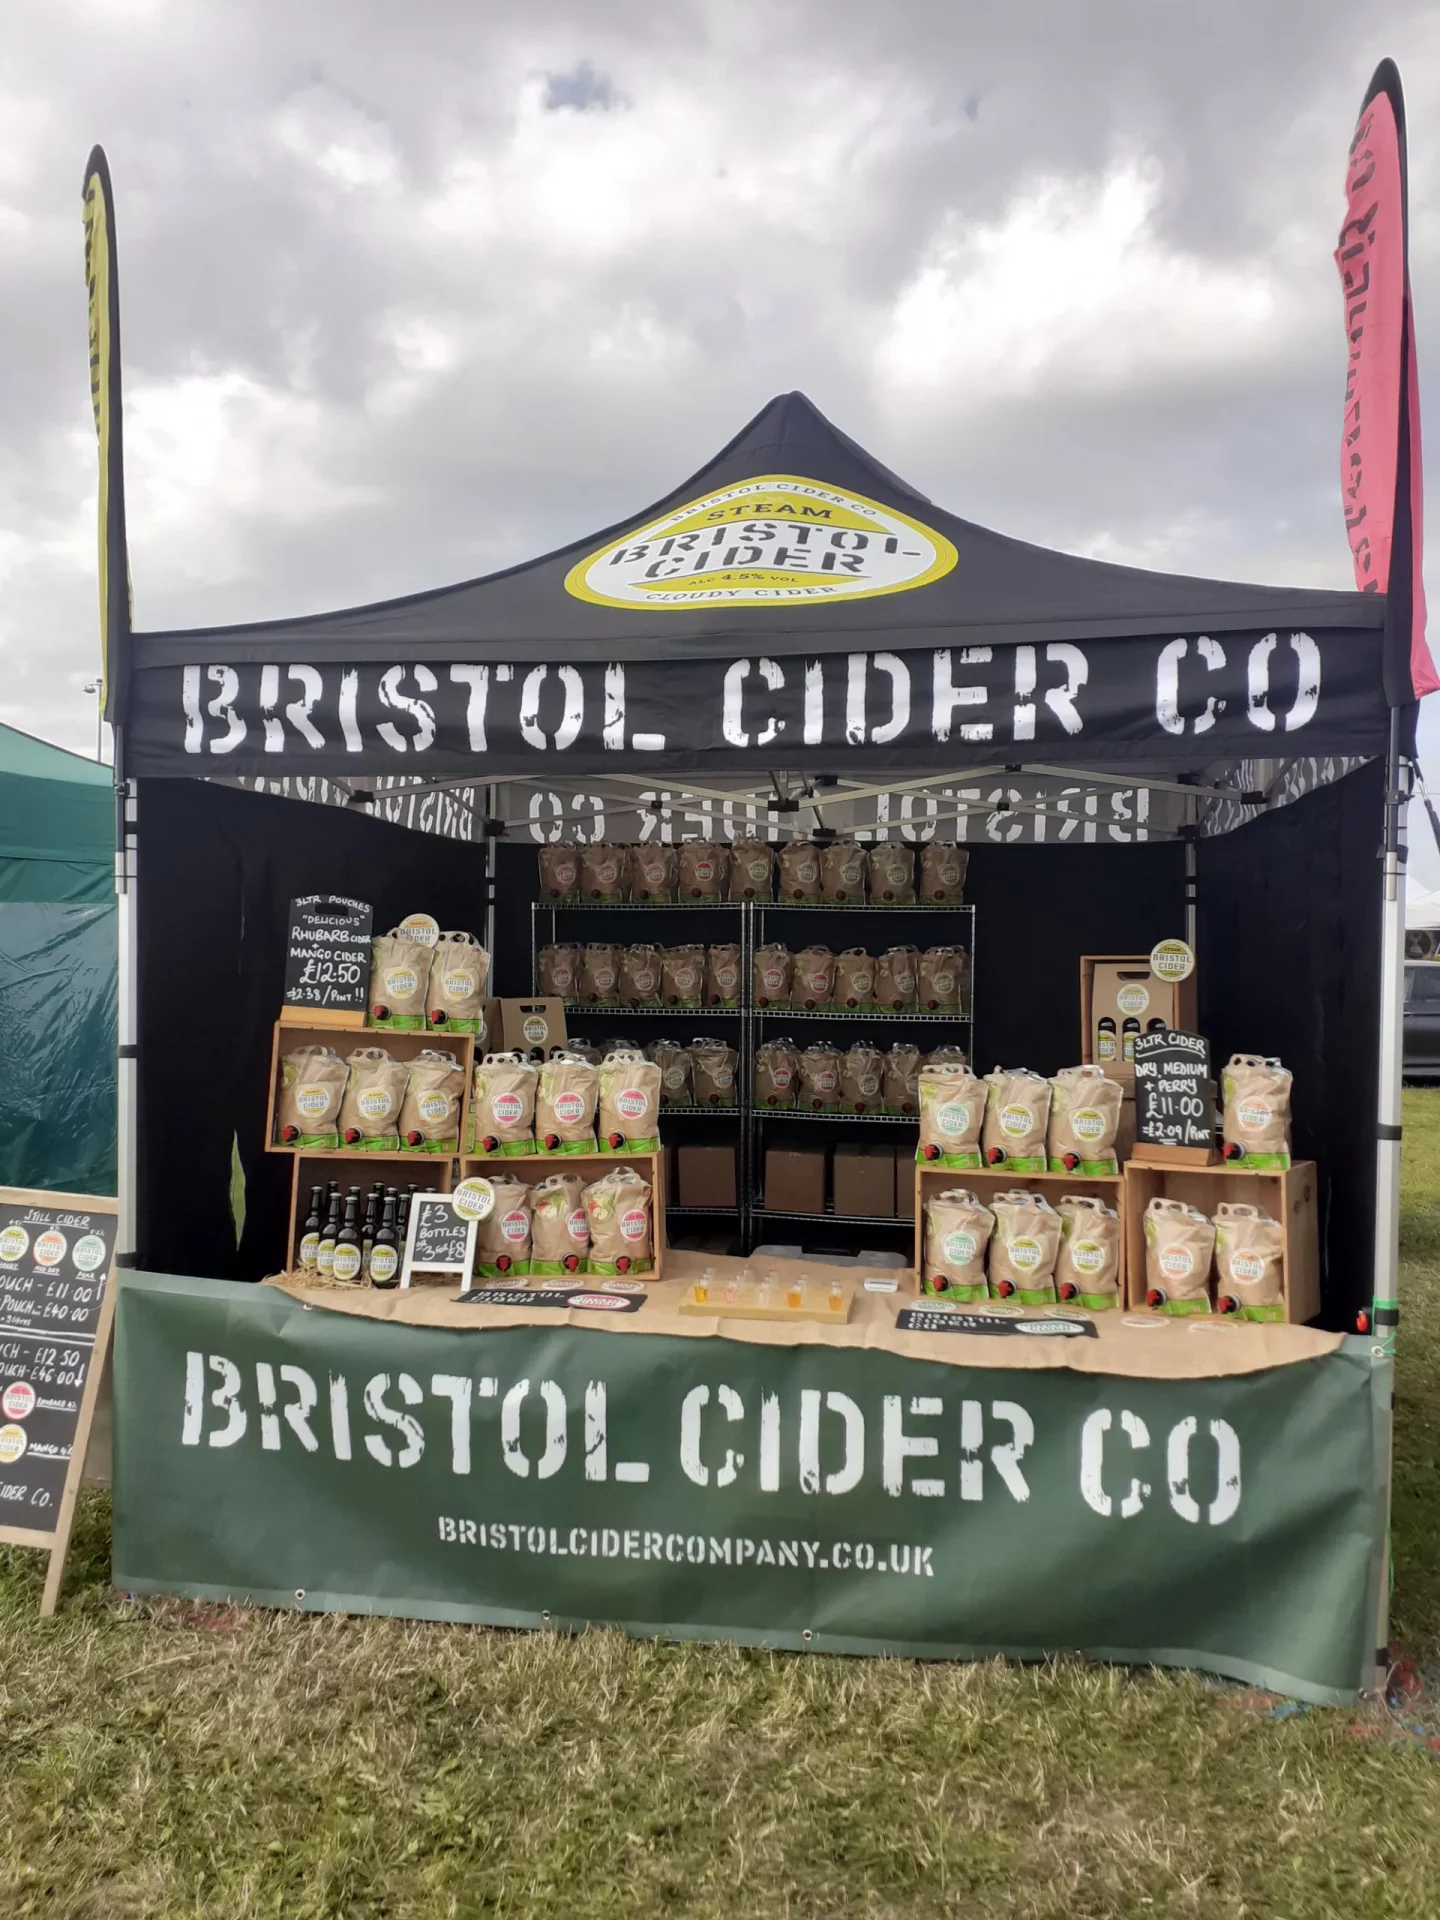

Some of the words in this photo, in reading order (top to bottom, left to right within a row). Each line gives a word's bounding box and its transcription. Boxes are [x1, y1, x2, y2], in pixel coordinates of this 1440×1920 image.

[670, 483, 768, 522] BRISTOL
[776, 482, 847, 506] CIDER
[851, 502, 877, 516] CO
[706, 502, 834, 521] STEAM
[608, 522, 923, 567] BRISTOL
[644, 545, 866, 579] CIDER
[720, 573, 766, 582] 4.5%
[770, 575, 799, 584] VOL
[645, 588, 742, 602] CLOUDY
[754, 585, 839, 598] CIDER
[182, 660, 666, 755] BRISTOL
[722, 641, 1090, 748] CIDER
[1155, 630, 1322, 736] CO
[294, 894, 322, 908] 3LTR
[328, 894, 371, 914] POUCHES
[290, 925, 349, 944] RHUBARB
[350, 934, 372, 944] CIDER
[400, 927, 437, 936] BRISTOL
[289, 947, 332, 961] MANGO
[333, 949, 368, 964] CIDER
[1152, 953, 1193, 964] BRISTOL
[298, 958, 362, 985] £12.50
[1158, 962, 1186, 971] CIDER
[1134, 1033, 1168, 1051] 3LTR
[1168, 1032, 1207, 1055] CIDER
[1163, 1061, 1208, 1079] MEDIUM
[1157, 1078, 1198, 1095] PERRY
[1145, 1091, 1204, 1120] £11.00
[456, 1187, 493, 1207] BRISTOL
[458, 1197, 486, 1212] CIDER
[23, 1208, 51, 1222] STILL
[56, 1213, 91, 1228] CIDER
[419, 1225, 467, 1239] BOTTLES
[422, 1245, 437, 1261] 3
[445, 1239, 466, 1262] £8
[181, 1350, 651, 1484] BRISTOL
[679, 1383, 1036, 1503] CIDER
[1080, 1407, 1242, 1526] CO
[28, 1442, 60, 1455] MANGO
[30, 1487, 54, 1508] CO.
[437, 1515, 935, 1577] BRISTOLCIDERCOMPANY.CO.UK
